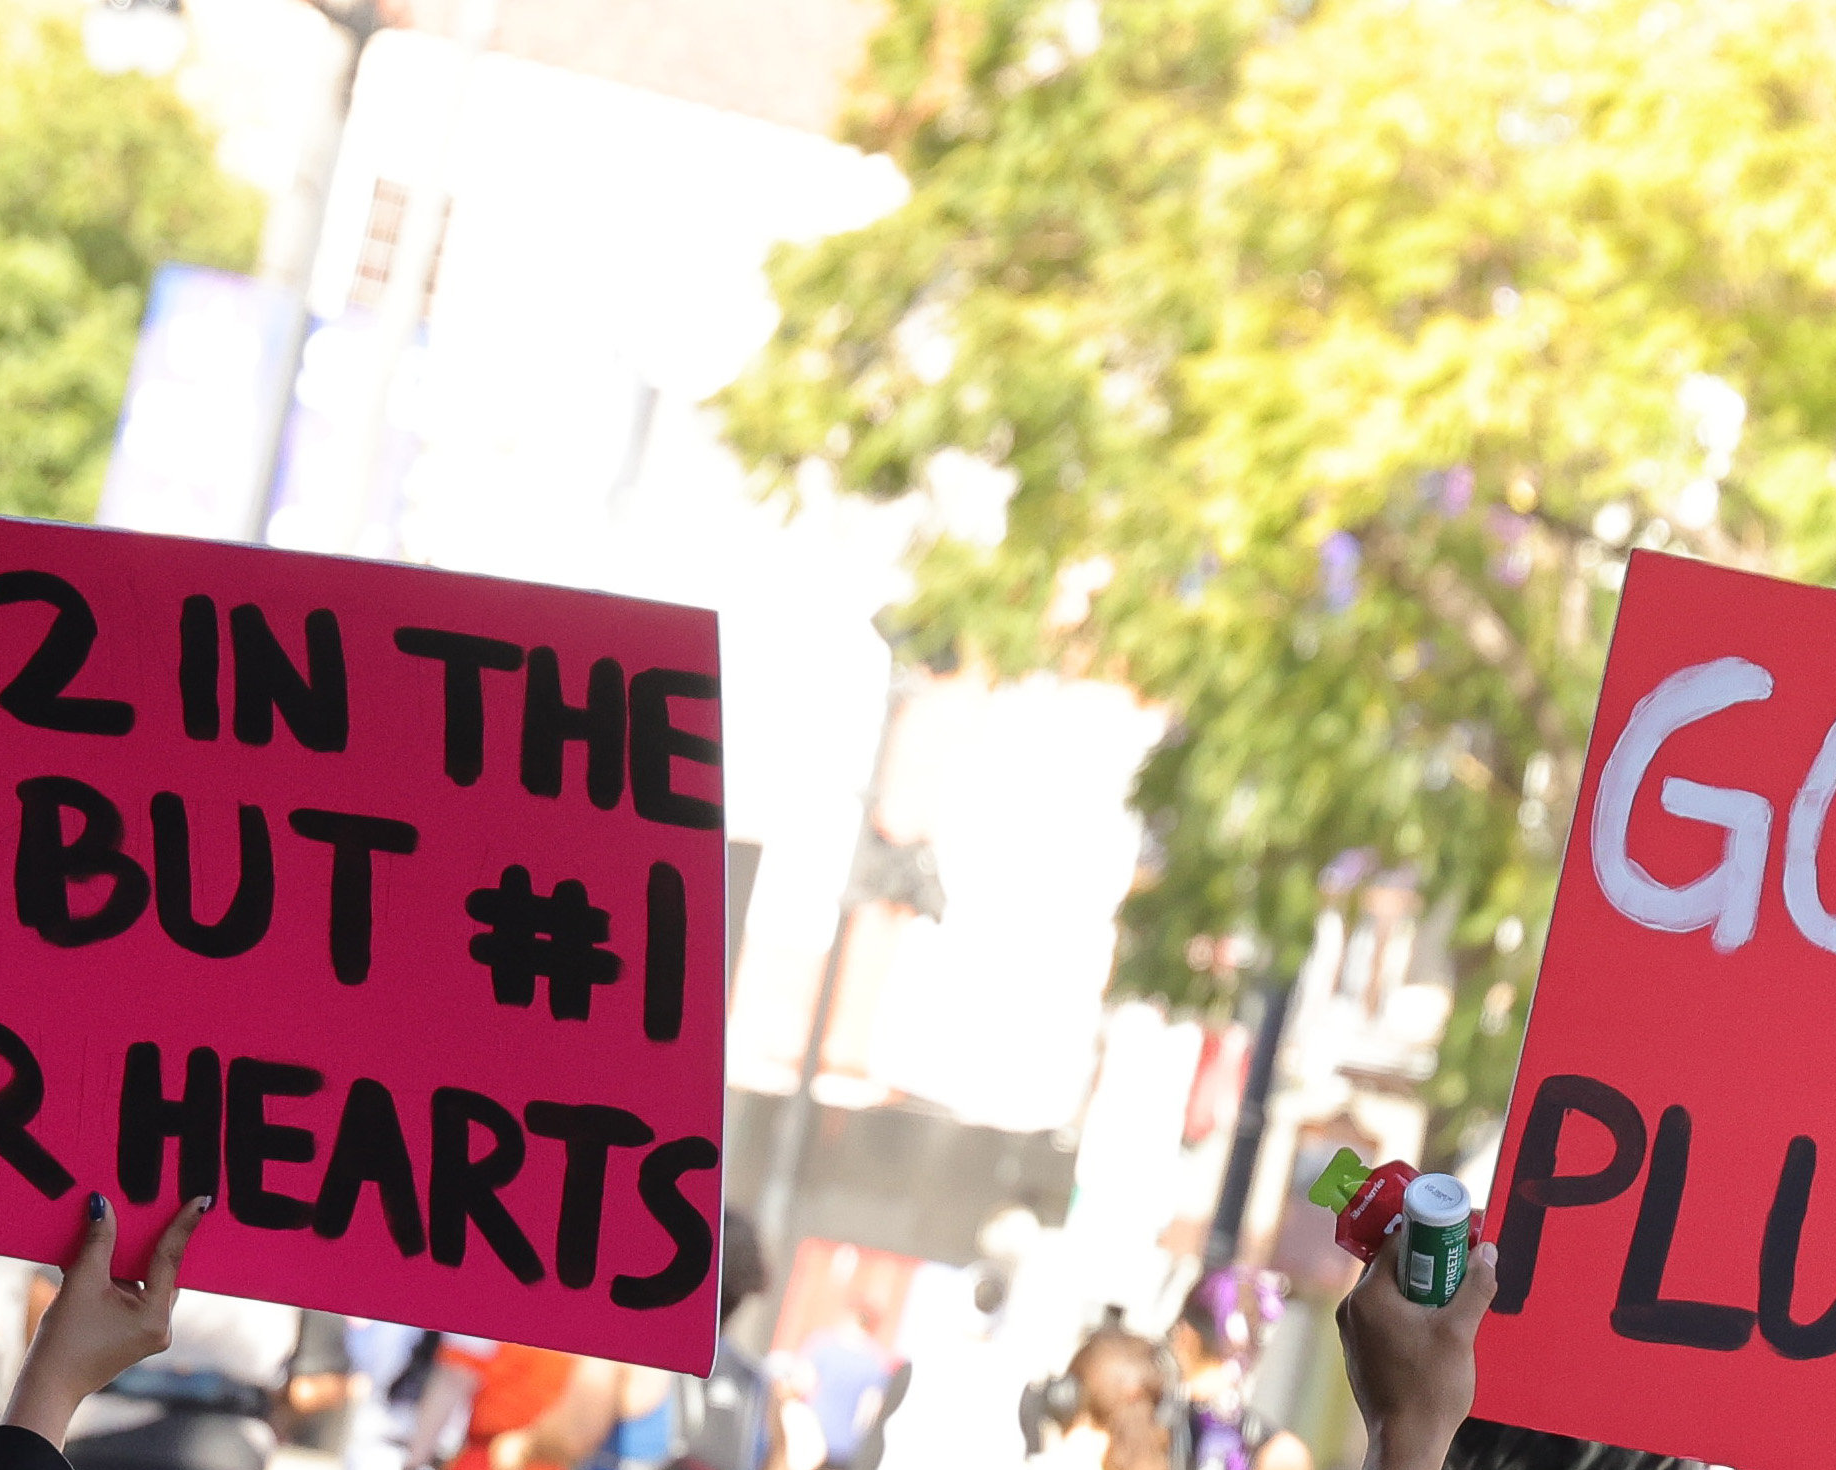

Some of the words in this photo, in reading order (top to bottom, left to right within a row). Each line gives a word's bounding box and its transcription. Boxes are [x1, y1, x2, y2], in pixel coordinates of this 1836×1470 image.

[178, 593, 351, 754] IN
[392, 626, 723, 831] THE
[13, 775, 420, 987] BUT
[464, 860, 689, 1044] #1
[116, 1040, 721, 1311] HEARTS
